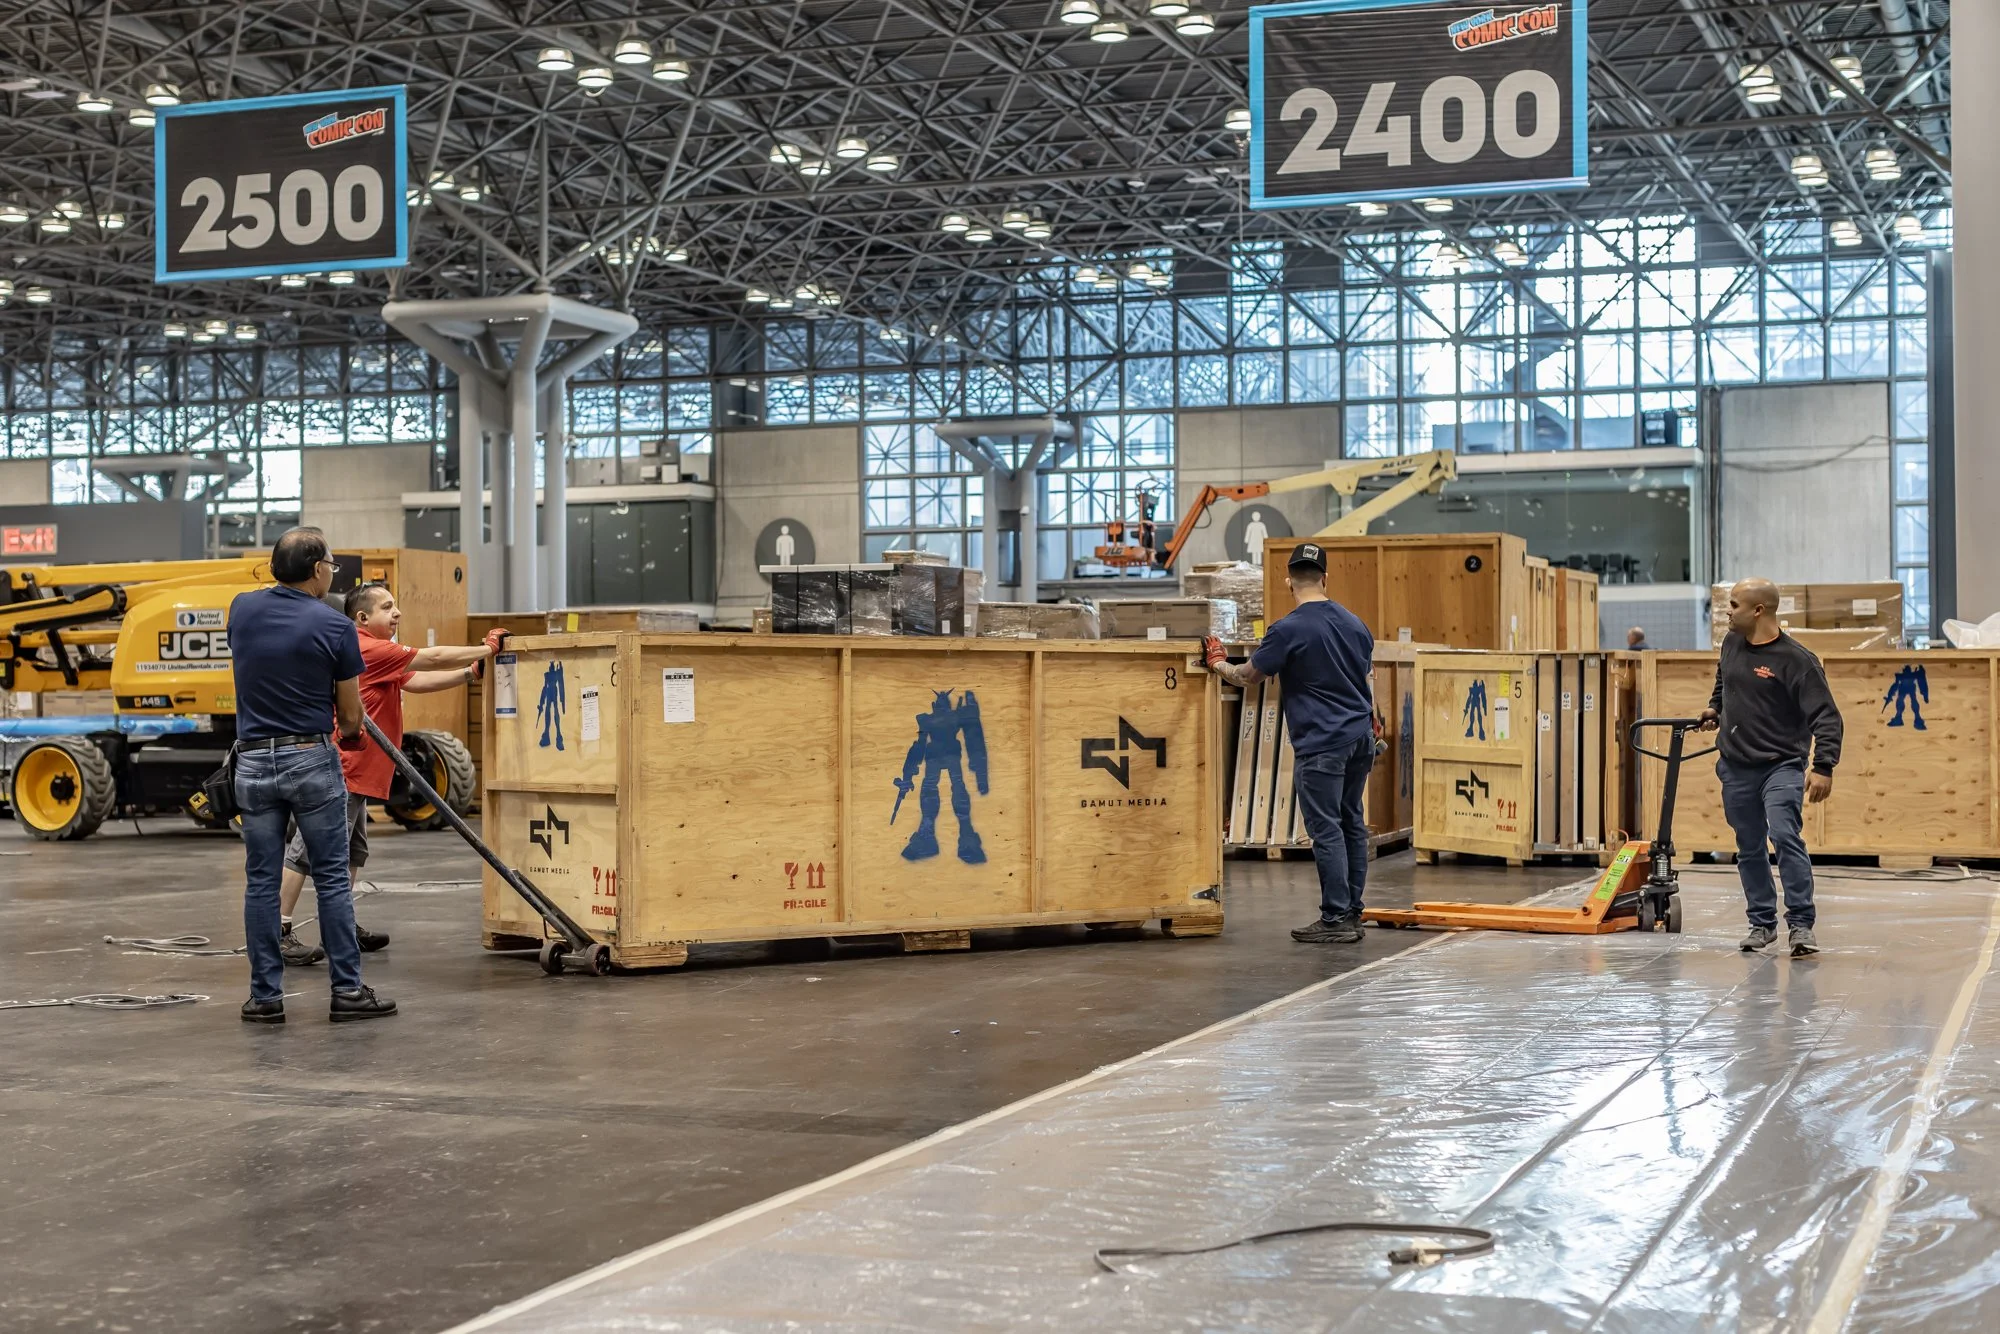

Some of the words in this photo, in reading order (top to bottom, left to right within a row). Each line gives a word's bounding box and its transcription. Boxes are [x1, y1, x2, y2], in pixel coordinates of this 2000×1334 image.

[1455, 17, 1515, 48] COMIC
[1517, 6, 1556, 33] CON
[309, 120, 353, 146] COMIC
[355, 110, 383, 133] CON
[1277, 69, 1561, 175] 2400
[179, 164, 384, 253] 2500
[4, 527, 54, 552] Exit
[1470, 558, 1477, 568] 2
[160, 632, 232, 660] JCB
[1165, 667, 1177, 690] 8
[1514, 681, 1522, 699] 5
[1081, 799, 1122, 808] GAMUT
[1128, 798, 1167, 806] MEDIA
[783, 899, 827, 910] FRAGILE
